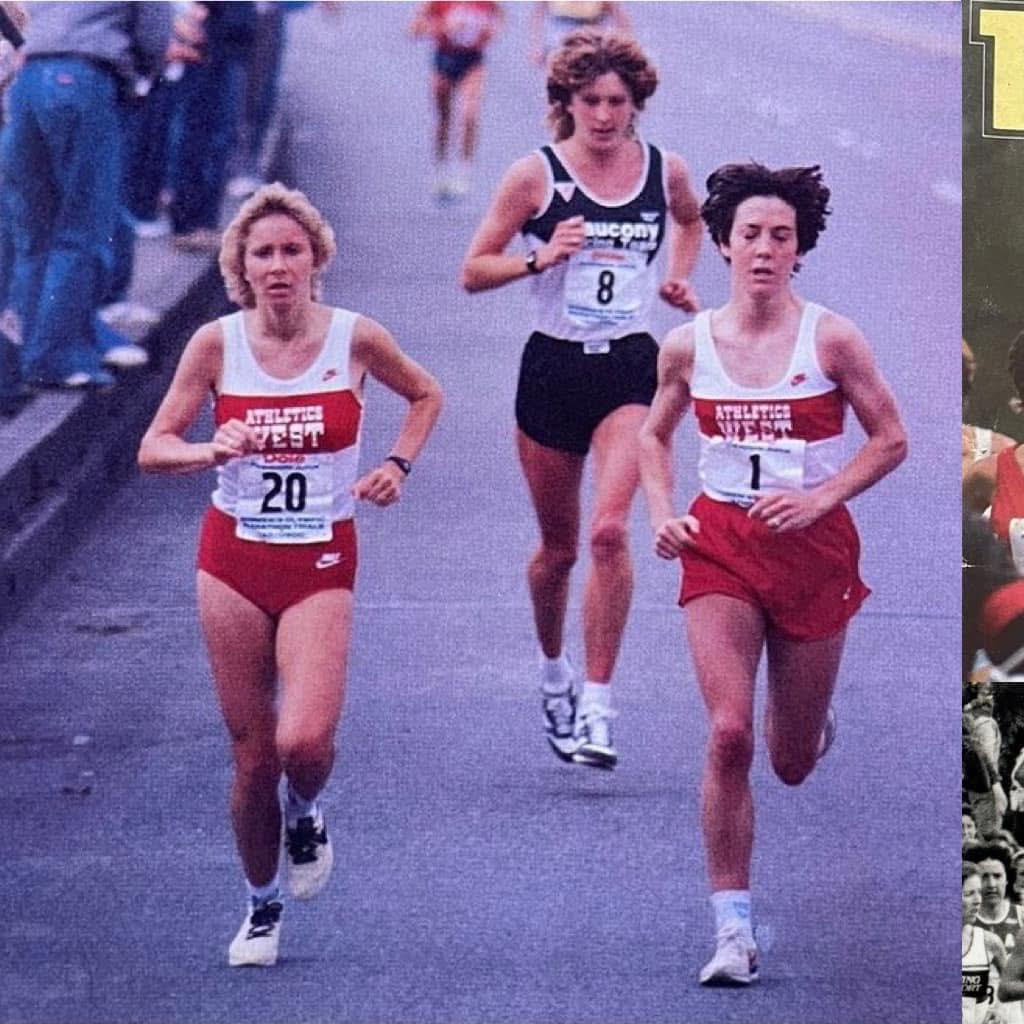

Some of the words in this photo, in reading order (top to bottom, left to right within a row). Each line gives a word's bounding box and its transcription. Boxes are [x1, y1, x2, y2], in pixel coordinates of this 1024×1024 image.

[583, 221, 660, 242] aucony
[597, 270, 615, 305] 8
[246, 406, 323, 425] ATHLETICS
[715, 404, 792, 420] ATHLETICS
[717, 419, 794, 441] WEST
[750, 453, 761, 491] 1
[260, 471, 307, 514] 20
